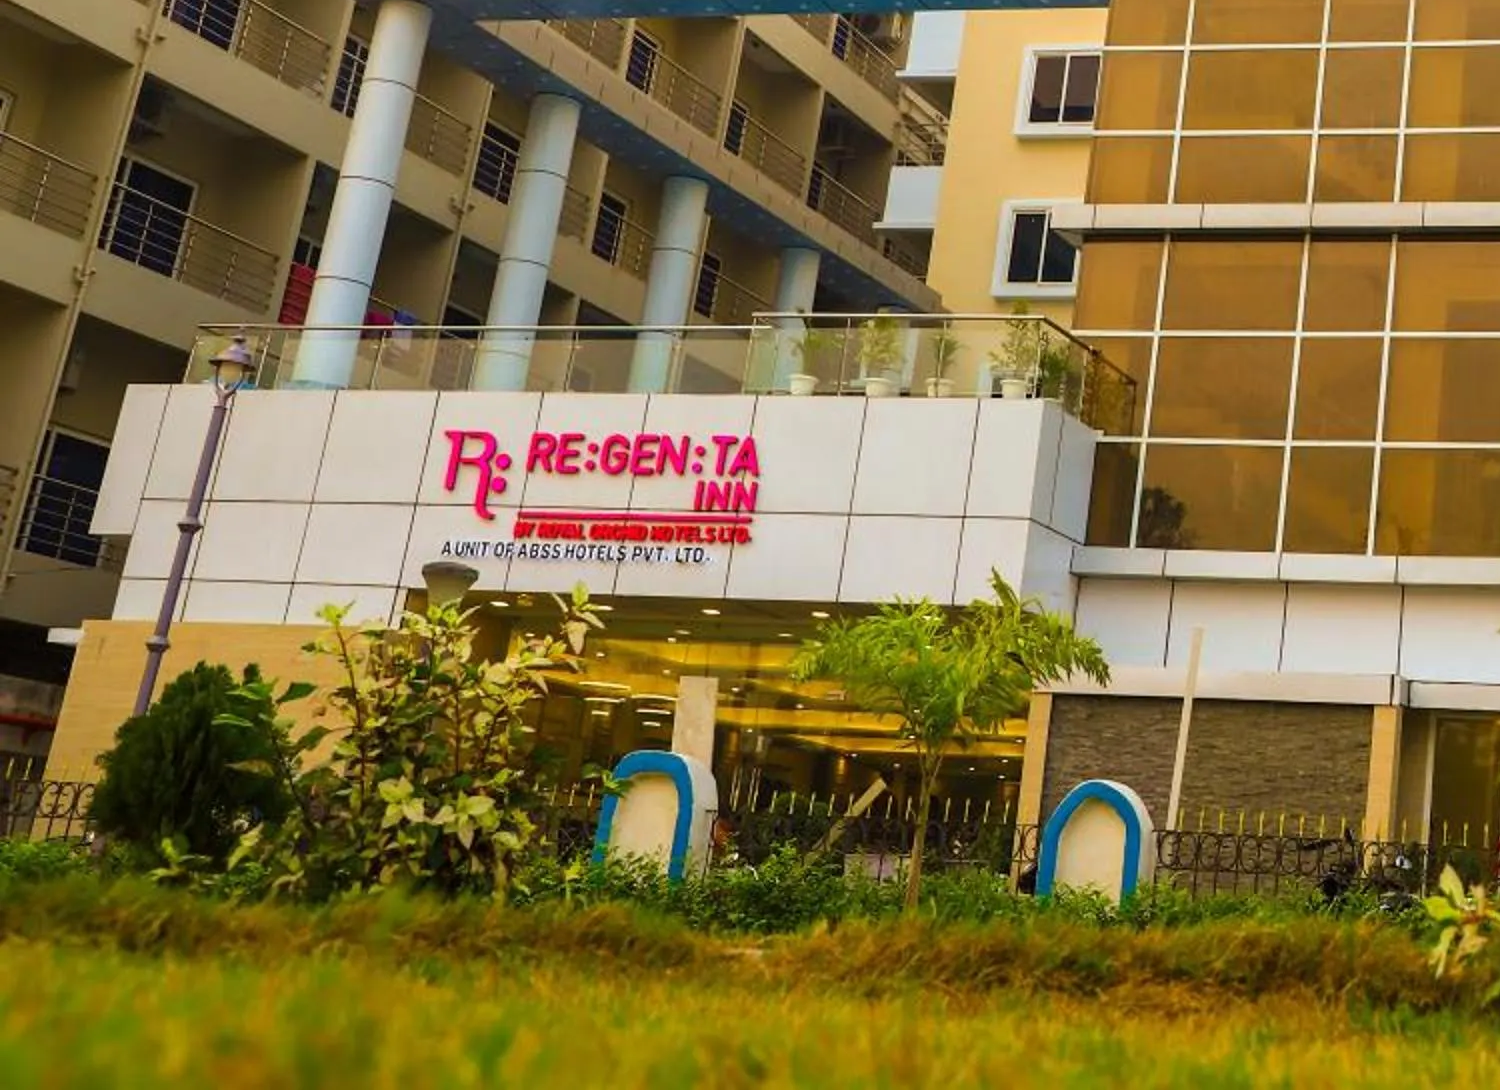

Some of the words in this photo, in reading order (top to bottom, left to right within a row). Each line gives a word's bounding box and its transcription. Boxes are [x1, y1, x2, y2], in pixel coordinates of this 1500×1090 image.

[526, 432, 760, 477] RE:GEN:TA
[694, 480, 759, 512] INN
[441, 541, 452, 556] A
[454, 541, 491, 557] UNIT
[493, 542, 515, 558] OF
[517, 543, 562, 559] ABSS
[563, 544, 627, 561] HOTELS
[631, 545, 670, 562] PVT.
[675, 547, 712, 563] LTD.
